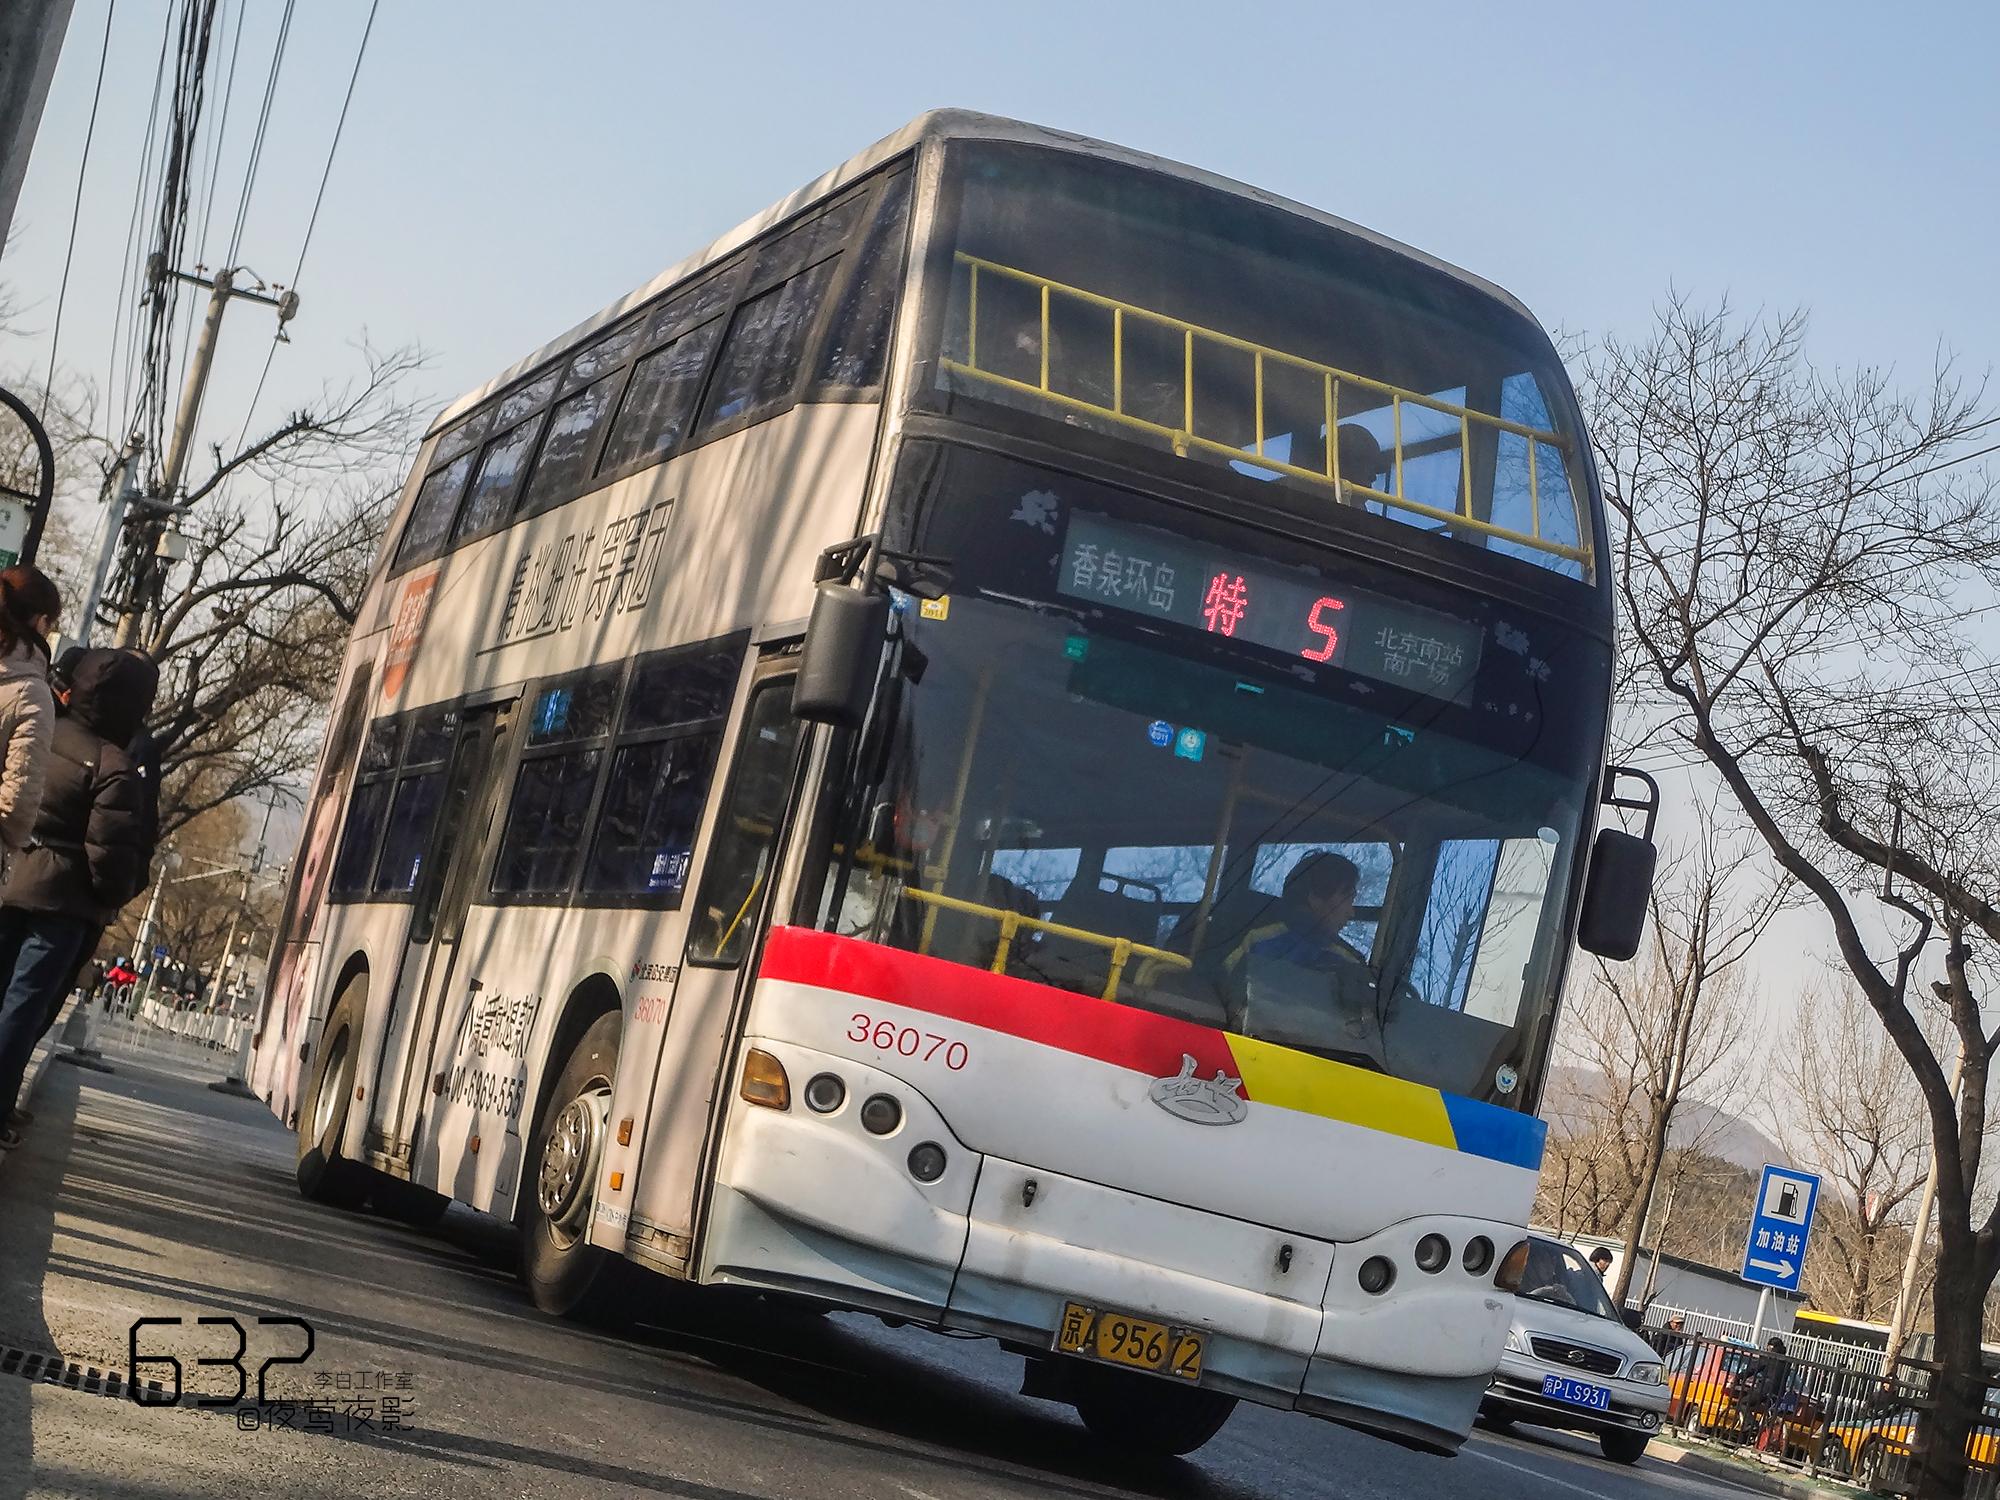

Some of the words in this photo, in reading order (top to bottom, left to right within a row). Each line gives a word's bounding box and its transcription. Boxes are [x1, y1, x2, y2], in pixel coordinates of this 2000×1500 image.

[1071, 543, 1177, 612] 香泉环岛
[1204, 572, 1249, 637] 特
[1300, 596, 1345, 662] 5
[1375, 626, 1465, 667] 北京南站
[1383, 651, 1451, 686] 南广场
[635, 996, 666, 1025] 36070
[846, 1013, 969, 1071] 36070
[1755, 1227, 1800, 1256] 加油站
